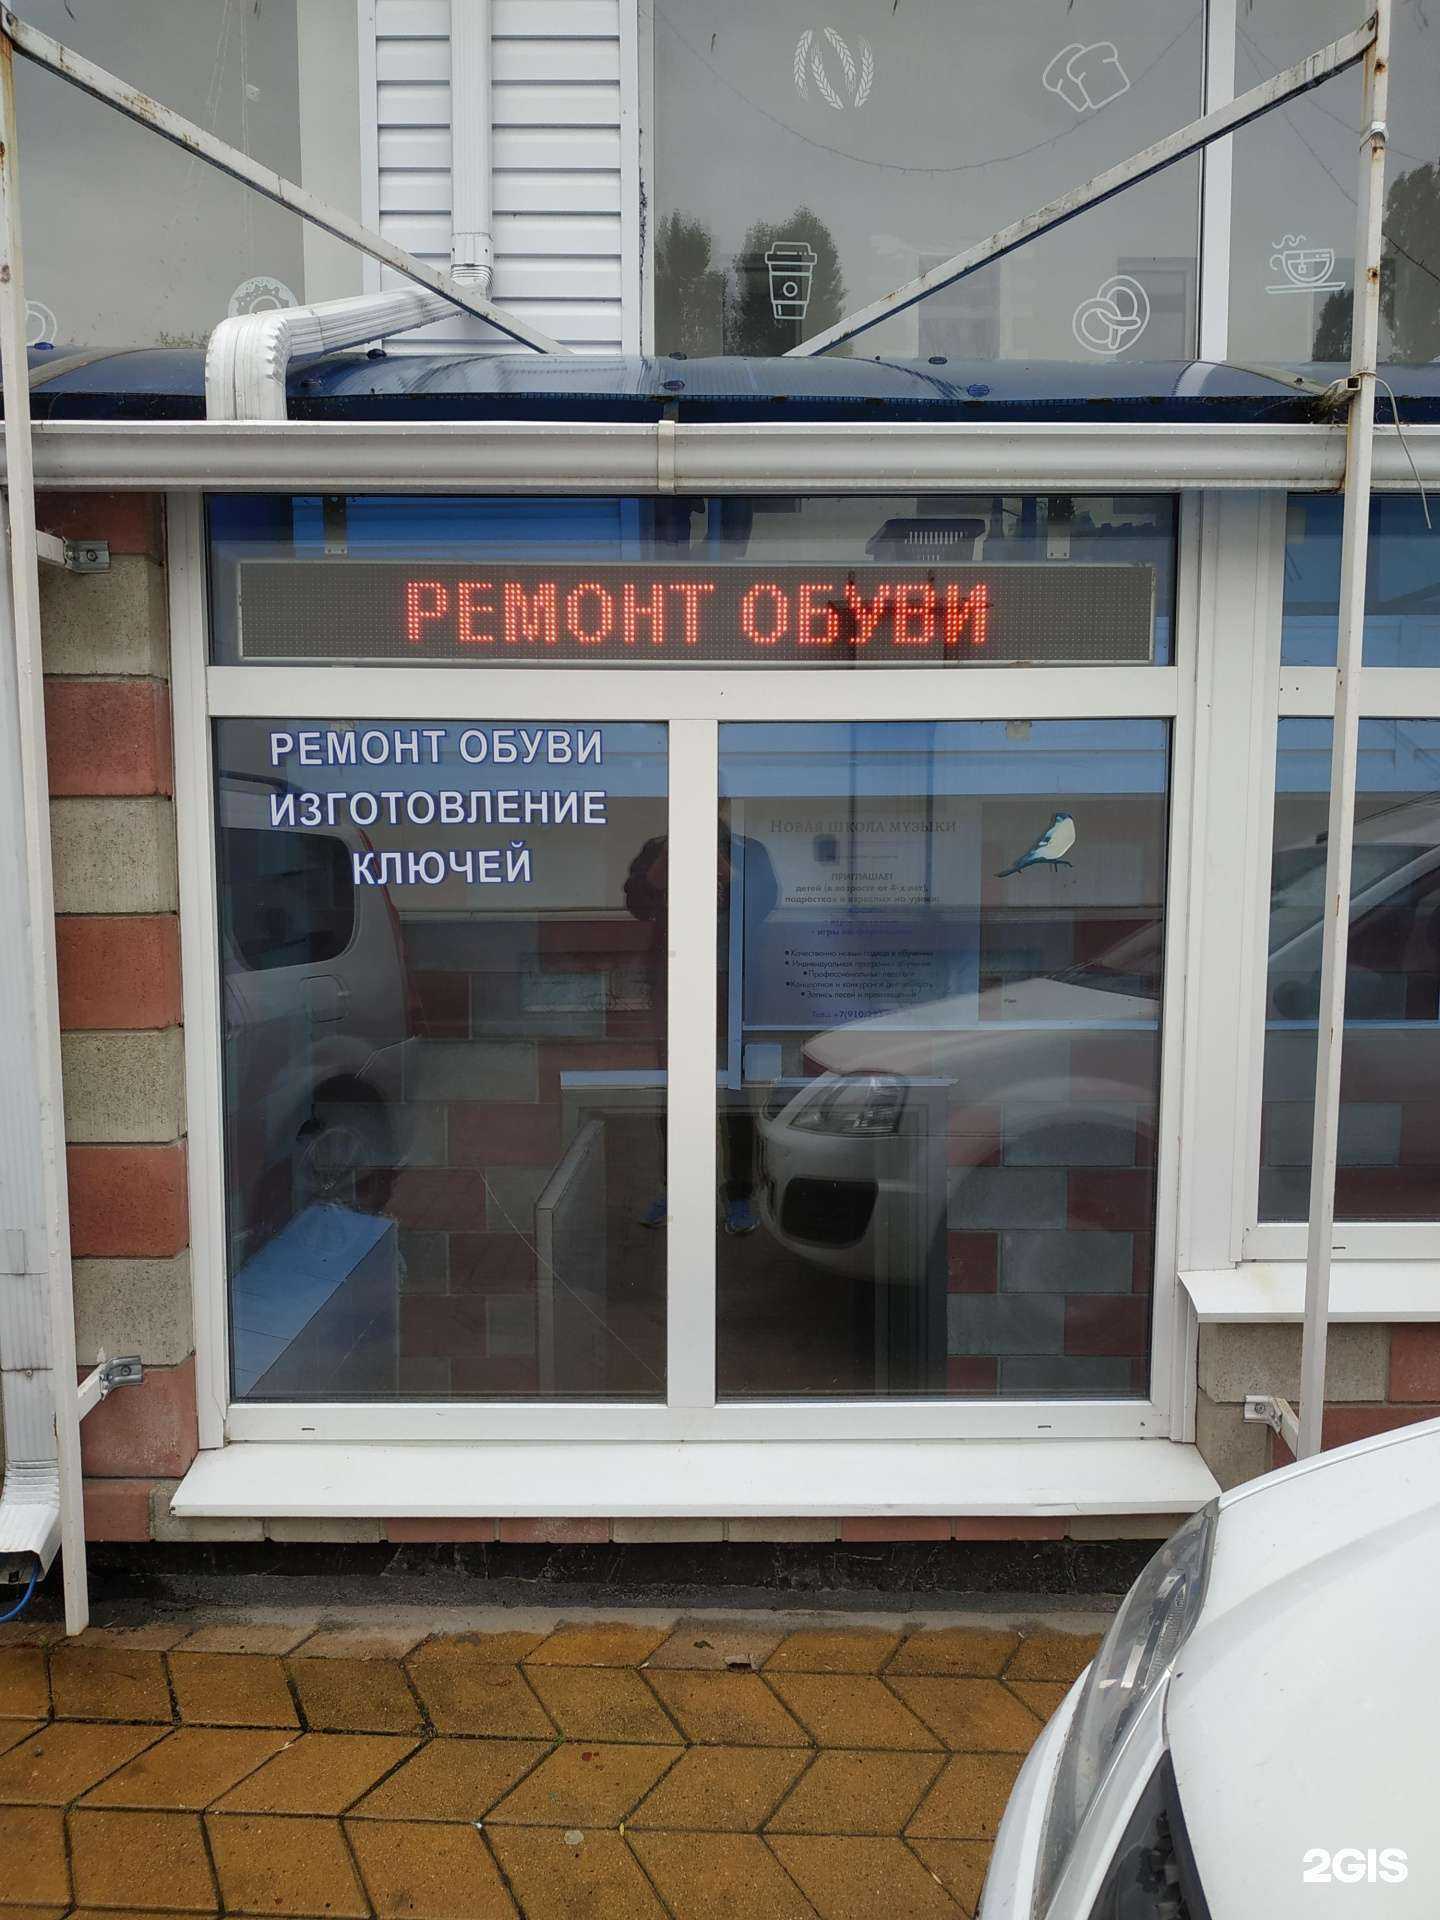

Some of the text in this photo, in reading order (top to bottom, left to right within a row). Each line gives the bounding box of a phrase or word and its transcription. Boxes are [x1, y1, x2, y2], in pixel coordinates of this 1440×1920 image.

[406, 581, 989, 646] РЕМОНТ ОБУВИ
[269, 728, 603, 767] РЕМОНТ ОБУВИ
[269, 790, 608, 828] ИЗГОТОВЛЕНИЕ
[352, 840, 533, 887] КЛЮЧЕЙ
